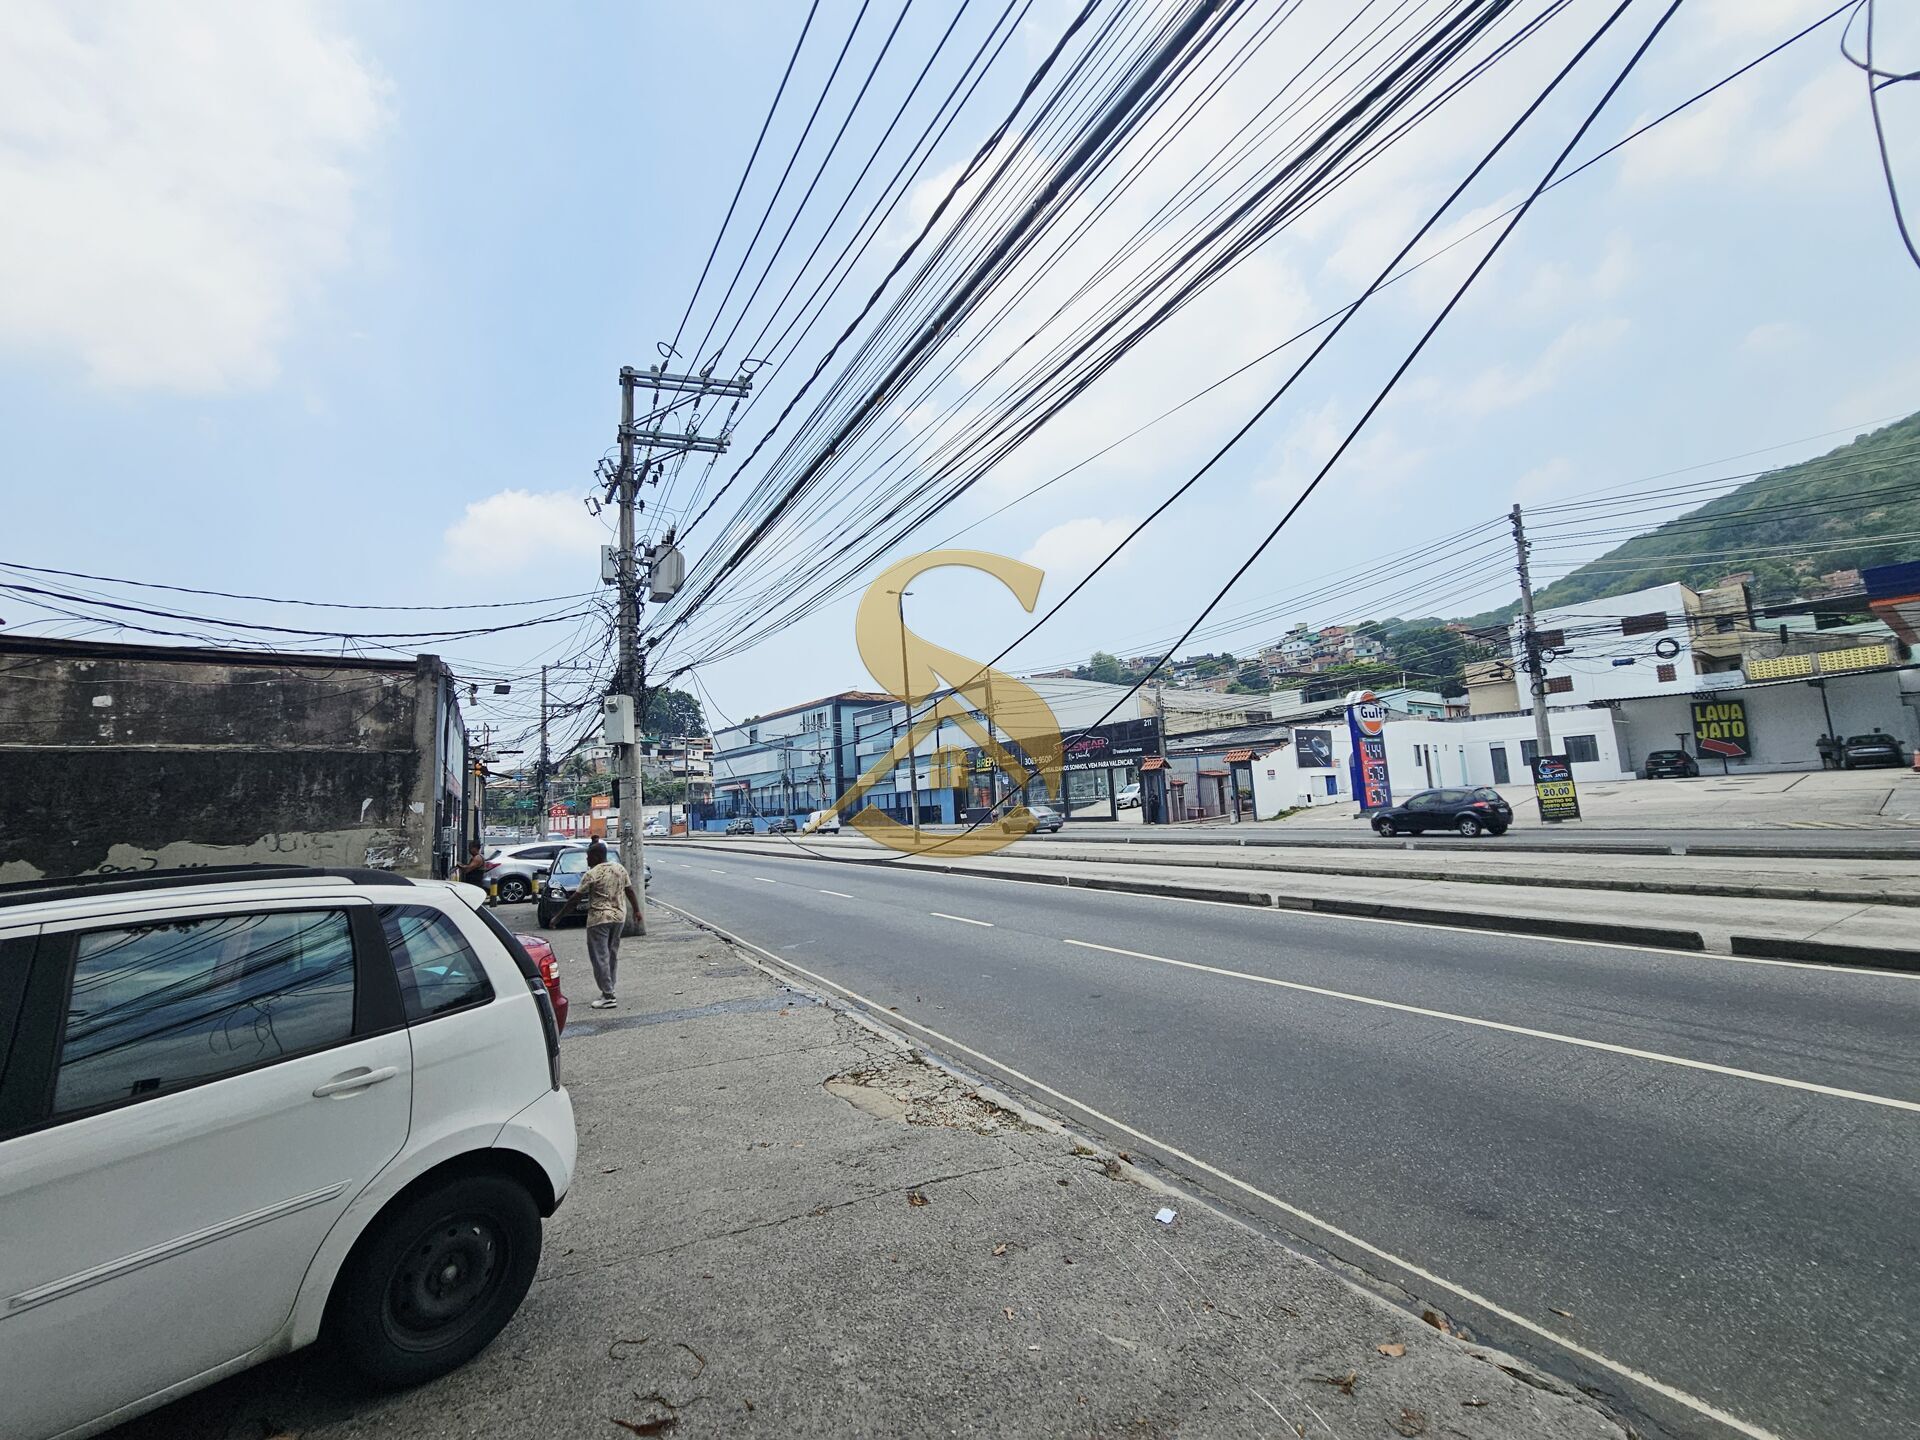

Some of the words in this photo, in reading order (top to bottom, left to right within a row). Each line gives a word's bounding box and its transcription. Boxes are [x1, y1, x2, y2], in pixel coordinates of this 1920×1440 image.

[1361, 706, 1383, 719] Gulf
[1695, 704, 1743, 721] LAVA
[1143, 719, 1152, 727] 211
[1696, 721, 1745, 739] JATO
